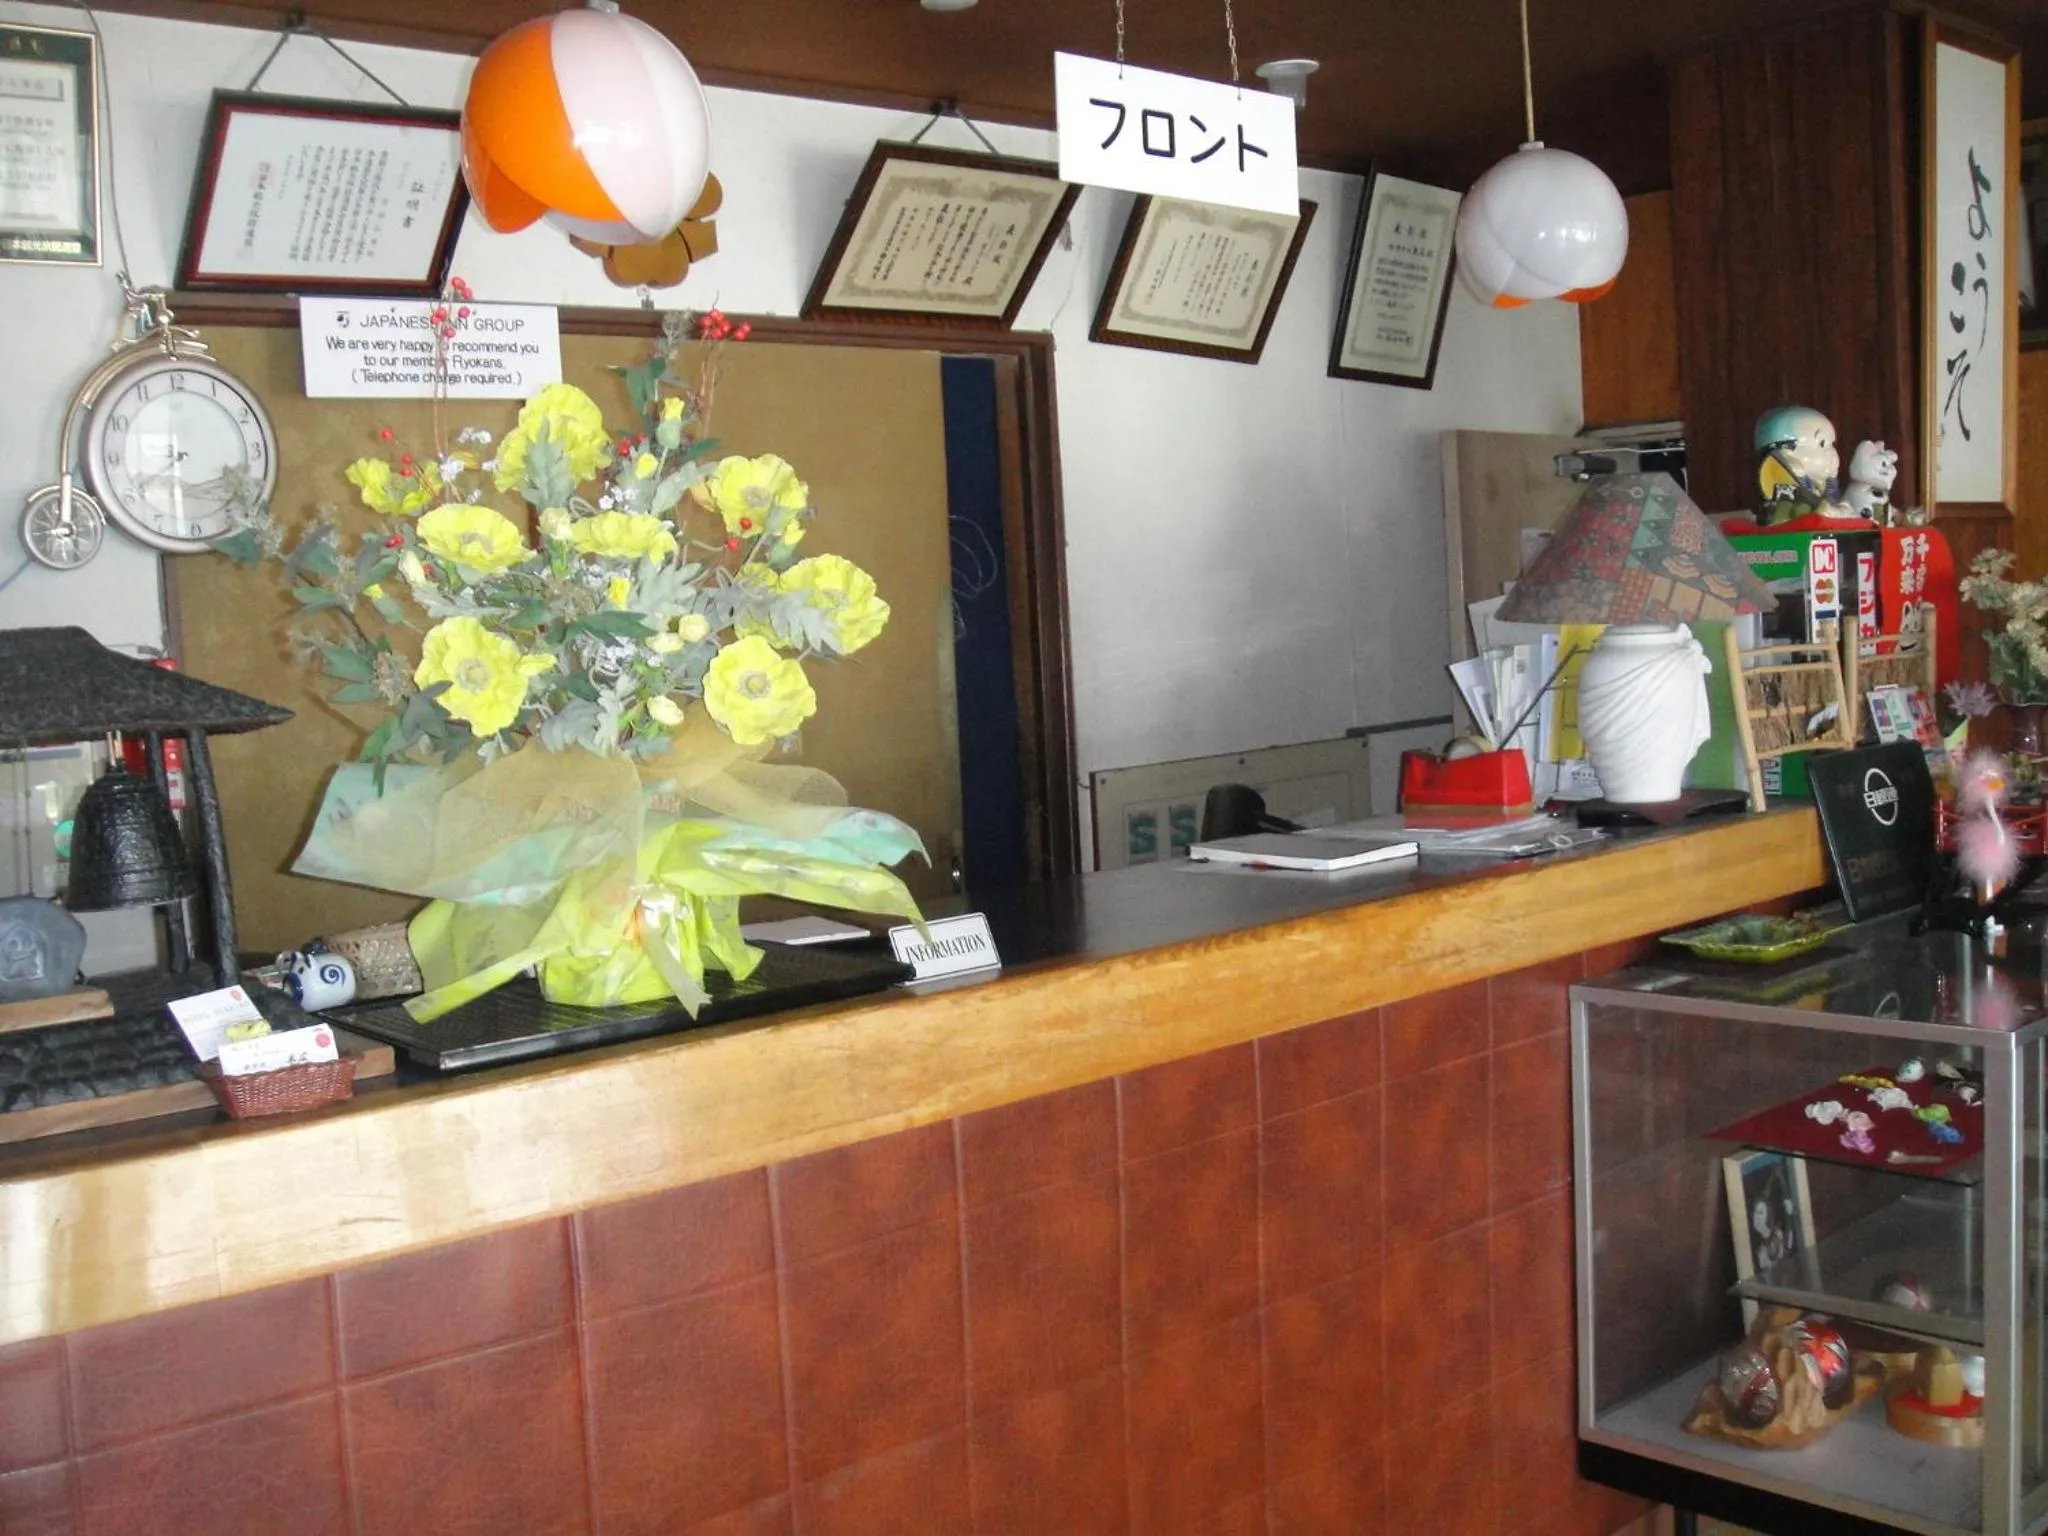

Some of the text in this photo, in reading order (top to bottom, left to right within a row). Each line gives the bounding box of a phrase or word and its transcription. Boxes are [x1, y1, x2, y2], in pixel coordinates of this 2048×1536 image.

[1089, 97, 1268, 172] フロント
[360, 315, 441, 330] JAPANES
[474, 317, 525, 332] GROUP
[326, 336, 345, 350] We
[348, 340, 370, 350] are
[371, 341, 397, 354] very
[400, 339, 434, 354] happy
[452, 341, 518, 353] recommend
[520, 343, 539, 355] you
[364, 355, 376, 367] to
[379, 357, 400, 367] our
[402, 355, 449, 368] membr
[170, 374, 185, 390] 12
[211, 381, 217, 398] 1
[137, 383, 149, 401] 11
[112, 415, 129, 432] 10
[239, 407, 249, 424] 2
[108, 451, 120, 466] 9
[251, 442, 262, 461] 3
